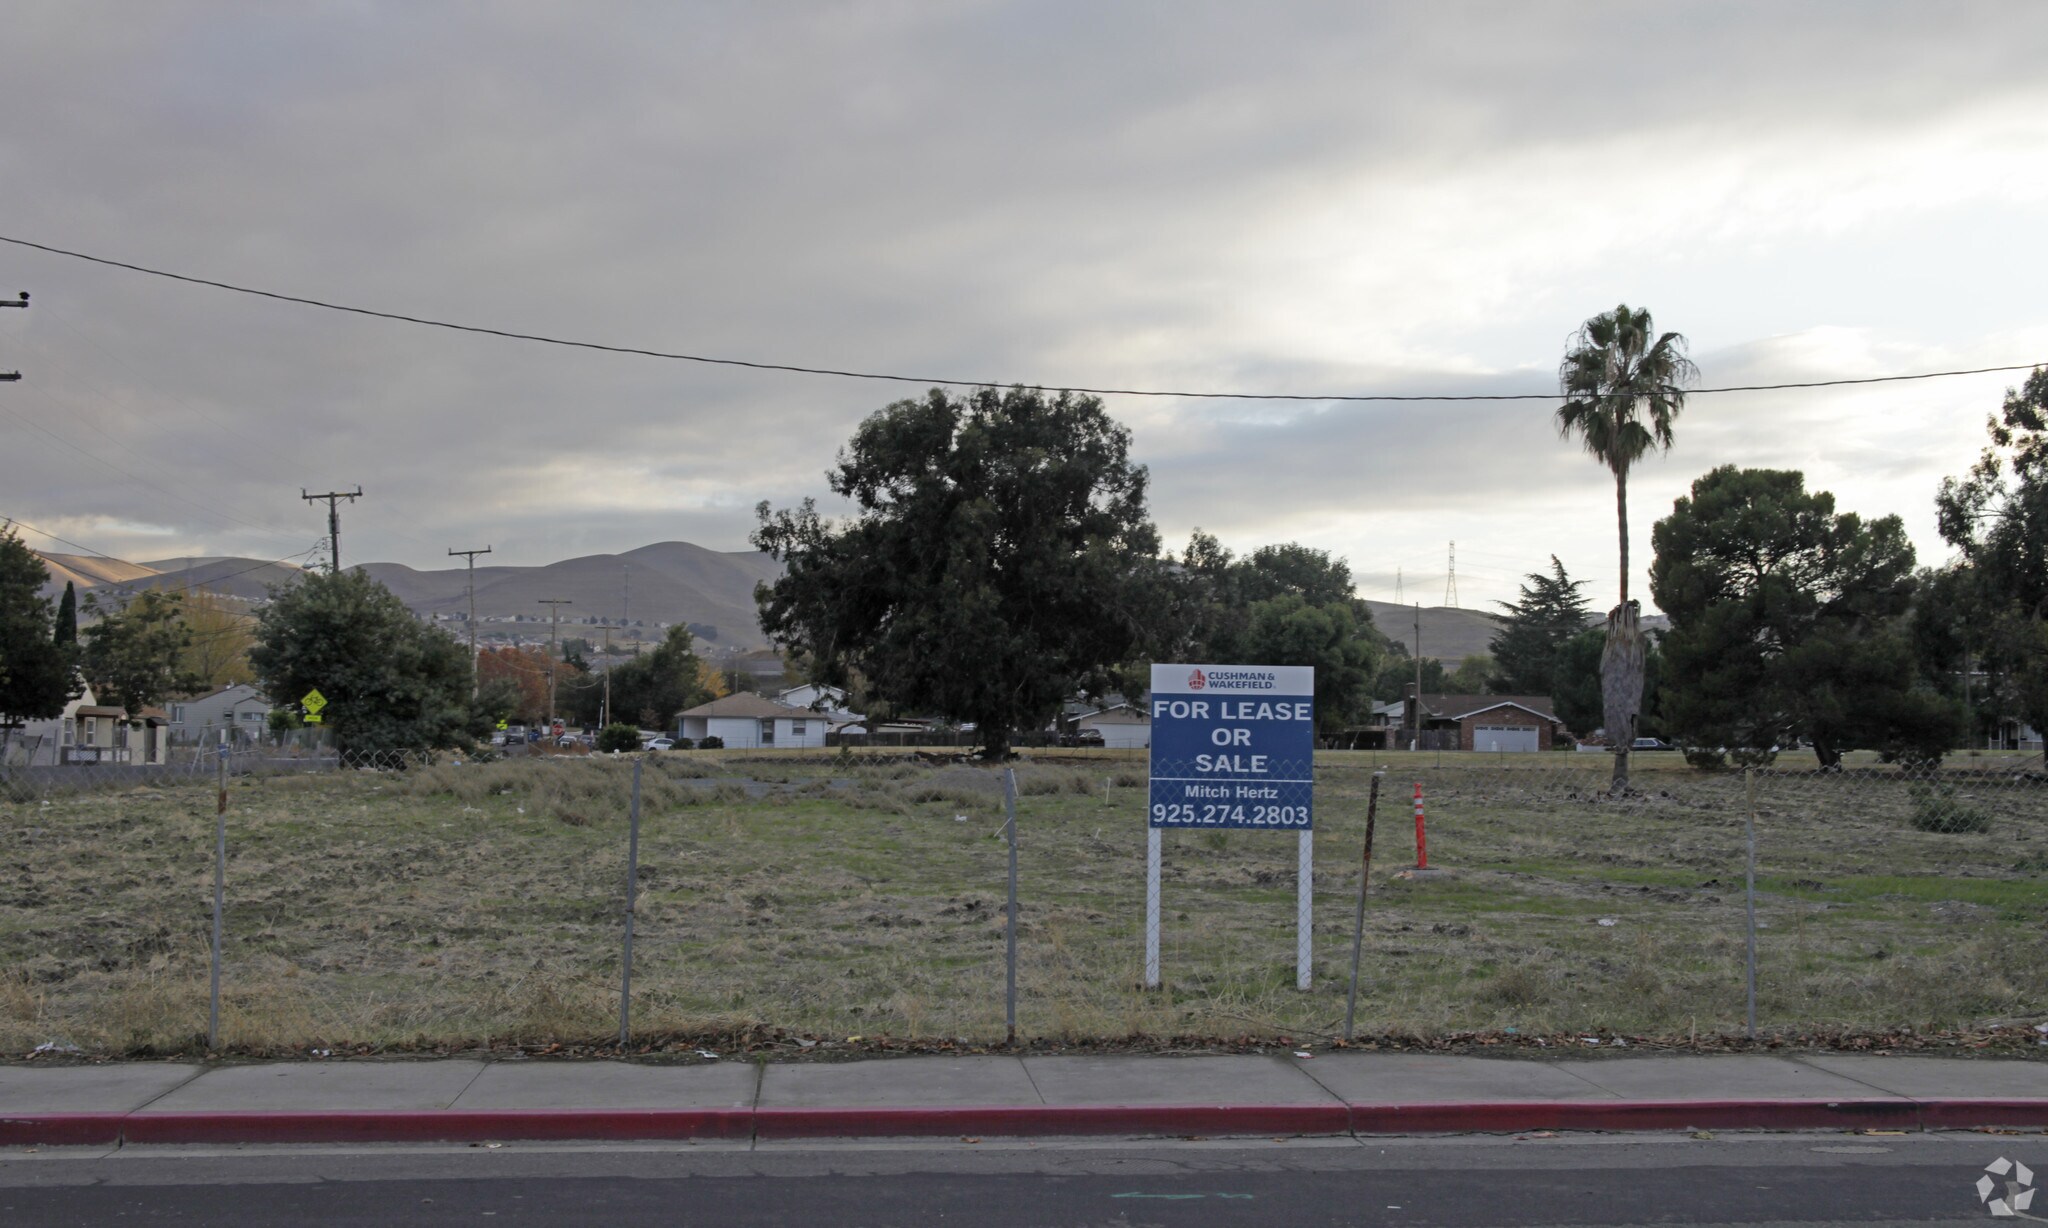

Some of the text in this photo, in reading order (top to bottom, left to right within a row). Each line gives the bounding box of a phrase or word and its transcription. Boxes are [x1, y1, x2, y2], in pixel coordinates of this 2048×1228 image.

[1208, 671, 1275, 681] CUSHMAN &
[1153, 700, 1311, 721] FOR LEASE
[1211, 728, 1252, 746] OR
[1195, 754, 1268, 773] SALE
[1185, 785, 1279, 799] Mitch Hertz
[1153, 803, 1309, 825] 925.274.2803
